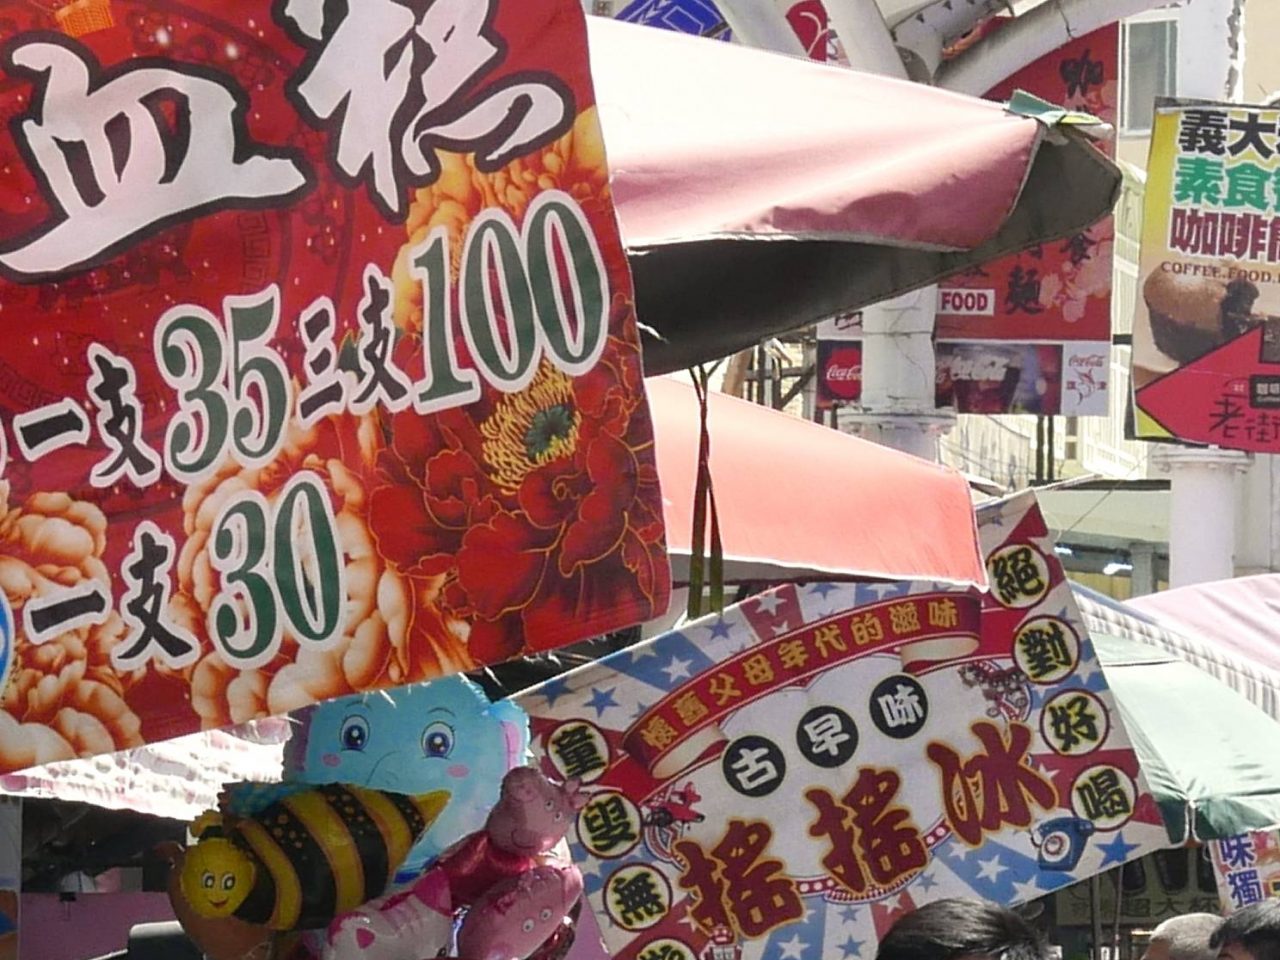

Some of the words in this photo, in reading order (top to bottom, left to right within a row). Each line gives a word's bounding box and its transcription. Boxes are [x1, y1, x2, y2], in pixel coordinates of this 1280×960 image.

[941, 292, 988, 311] FOOD
[28, 480, 342, 662] 一支30
[730, 683, 926, 788] 古早味
[986, 545, 1135, 822] 絕對好喝
[676, 720, 1058, 939] 搖搖冰
